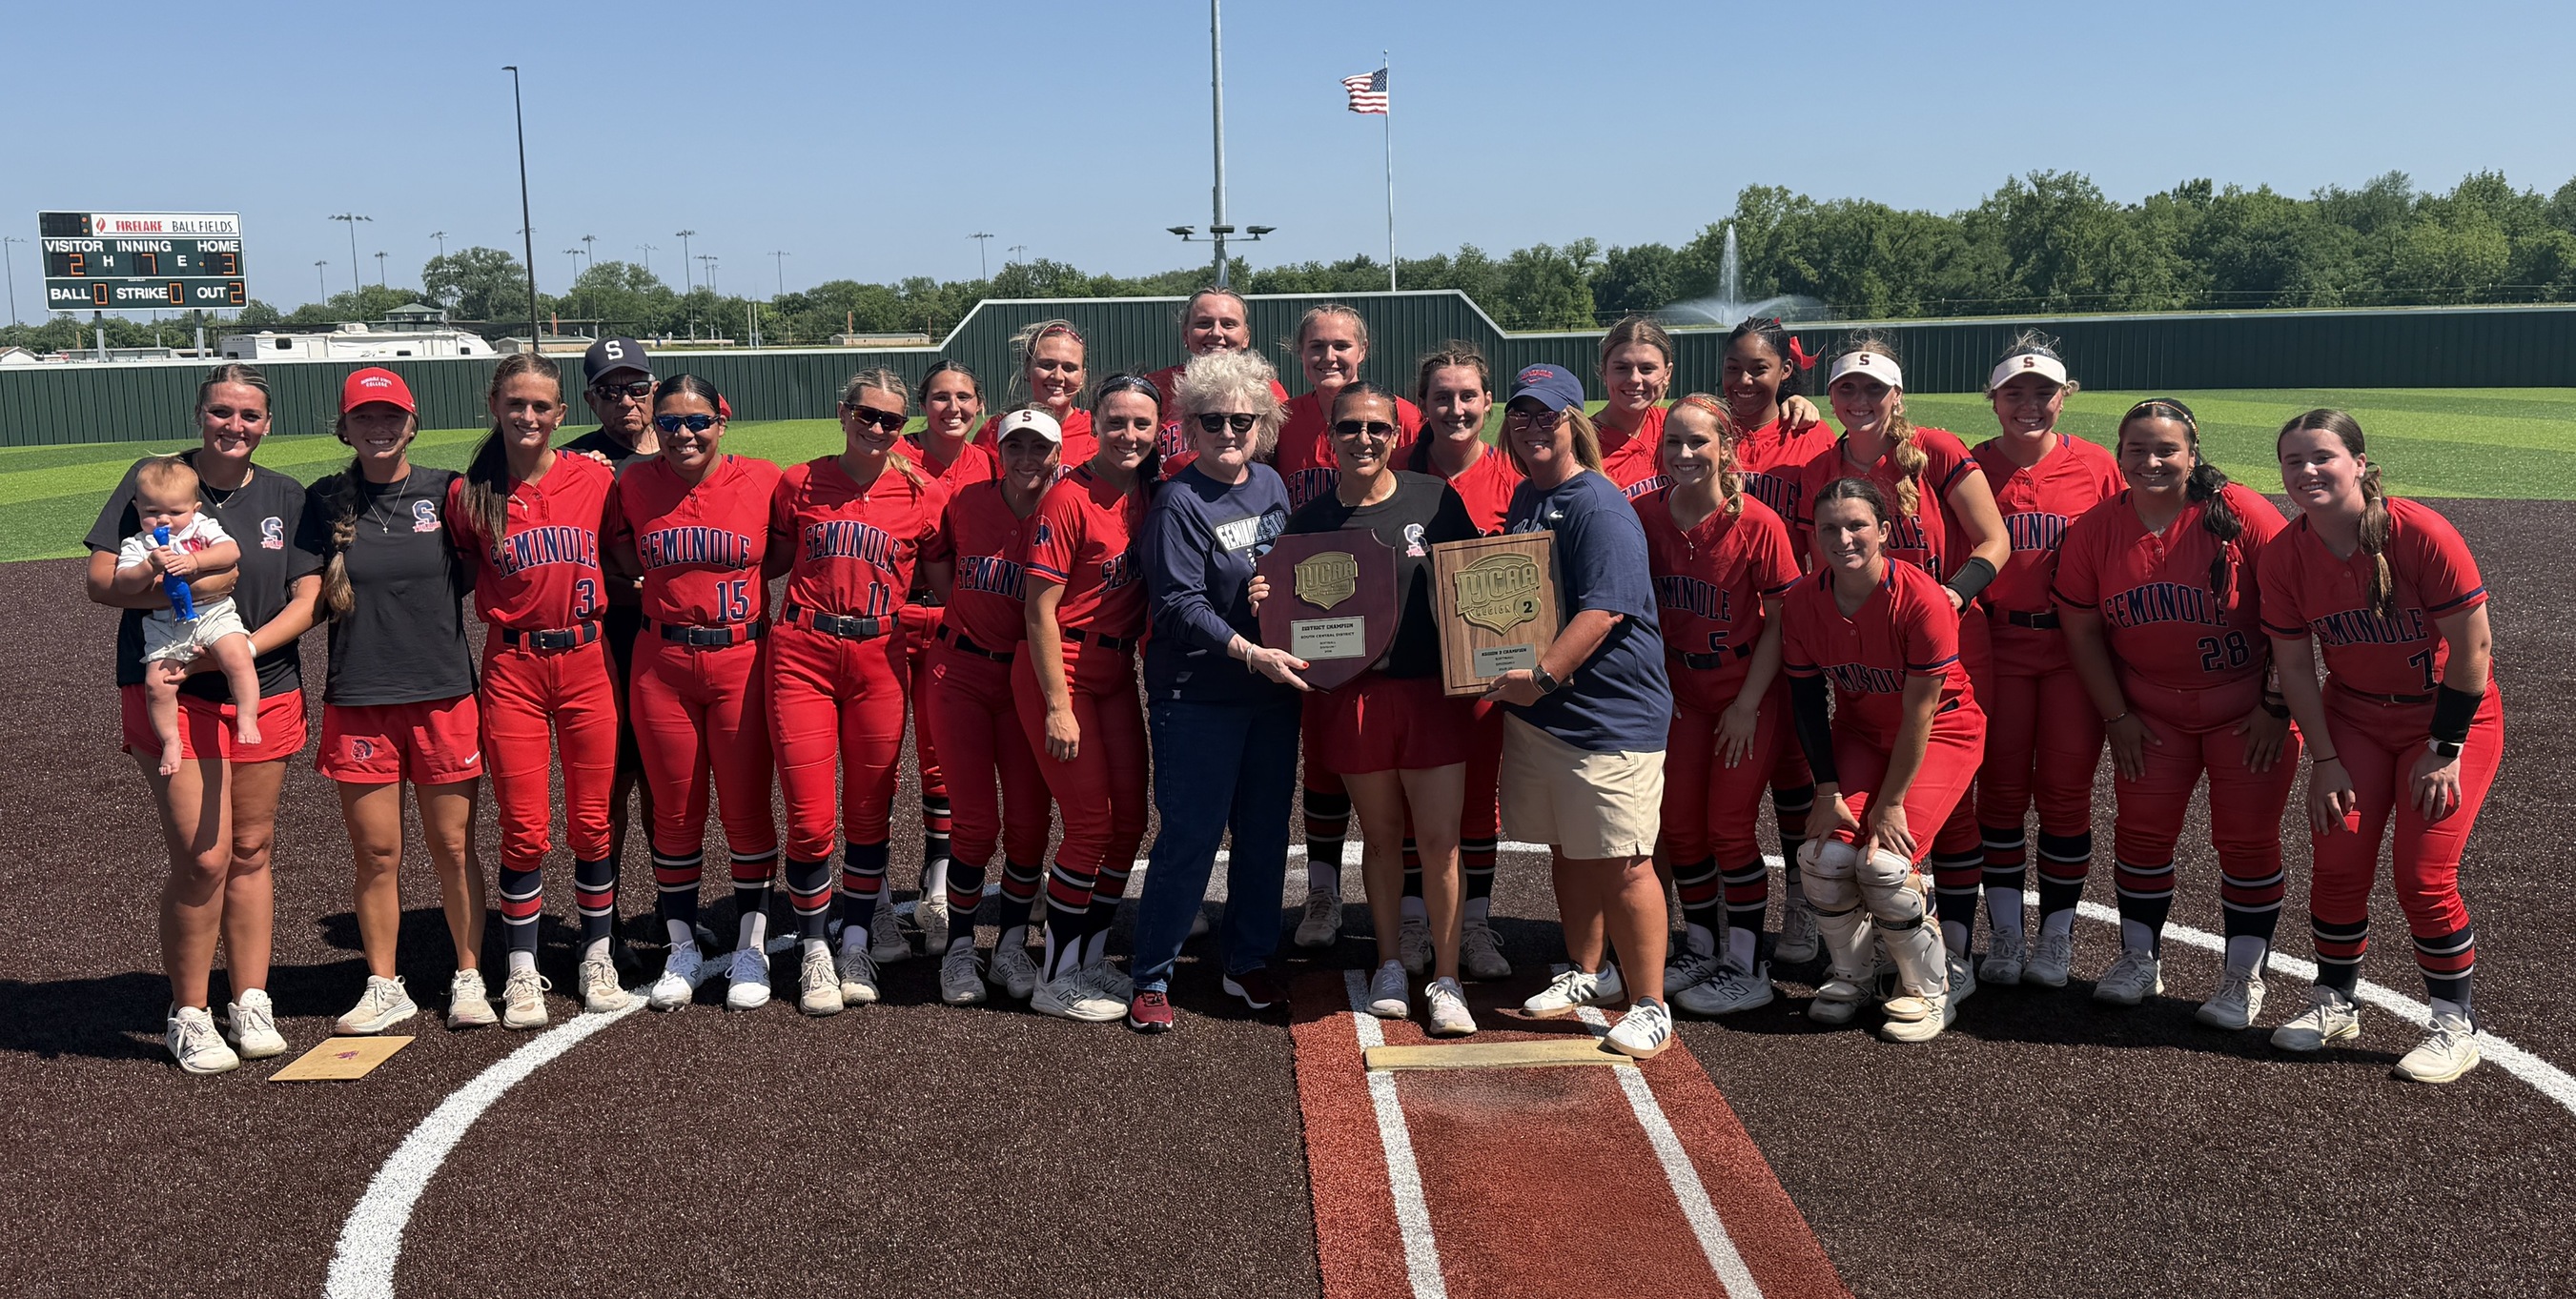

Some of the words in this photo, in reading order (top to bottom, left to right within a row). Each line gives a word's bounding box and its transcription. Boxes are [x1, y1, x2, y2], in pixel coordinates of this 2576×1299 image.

[115, 220, 163, 232] FIRELAKE
[173, 220, 196, 233] BALL
[199, 220, 233, 233] FIELDS
[45, 240, 104, 253] VISITOR
[116, 240, 172, 253] INNING
[197, 240, 239, 253] HOME
[69, 254, 85, 275] 2
[103, 255, 114, 267] H
[142, 254, 156, 274] 7
[177, 255, 188, 267] E
[221, 254, 236, 274] 3
[50, 288, 91, 300] BALL
[92, 283, 108, 305] 0
[116, 287, 169, 299] STRIKE
[169, 282, 184, 304] 0
[196, 287, 226, 298] OUT
[229, 282, 243, 304] 2
[604, 339, 624, 360] S
[1859, 354, 1870, 365] S
[2023, 356, 2034, 368] S
[1022, 411, 1032, 422] S
[1288, 467, 1341, 509] SEMIN
[490, 525, 598, 579] SEMINOLE
[640, 525, 750, 572] SEMINOLE
[805, 519, 901, 577] SEMINOLE
[1458, 564, 1538, 610] NJCAA
[575, 578, 596, 619] 3
[716, 579, 749, 622] 15
[866, 581, 891, 616] 11
[1523, 600, 1533, 613] 2
[2104, 582, 2228, 629] SEMINOLE
[2307, 608, 2429, 646] EMINOLE
[2197, 630, 2251, 673] 28
[2407, 647, 2439, 691] 7
